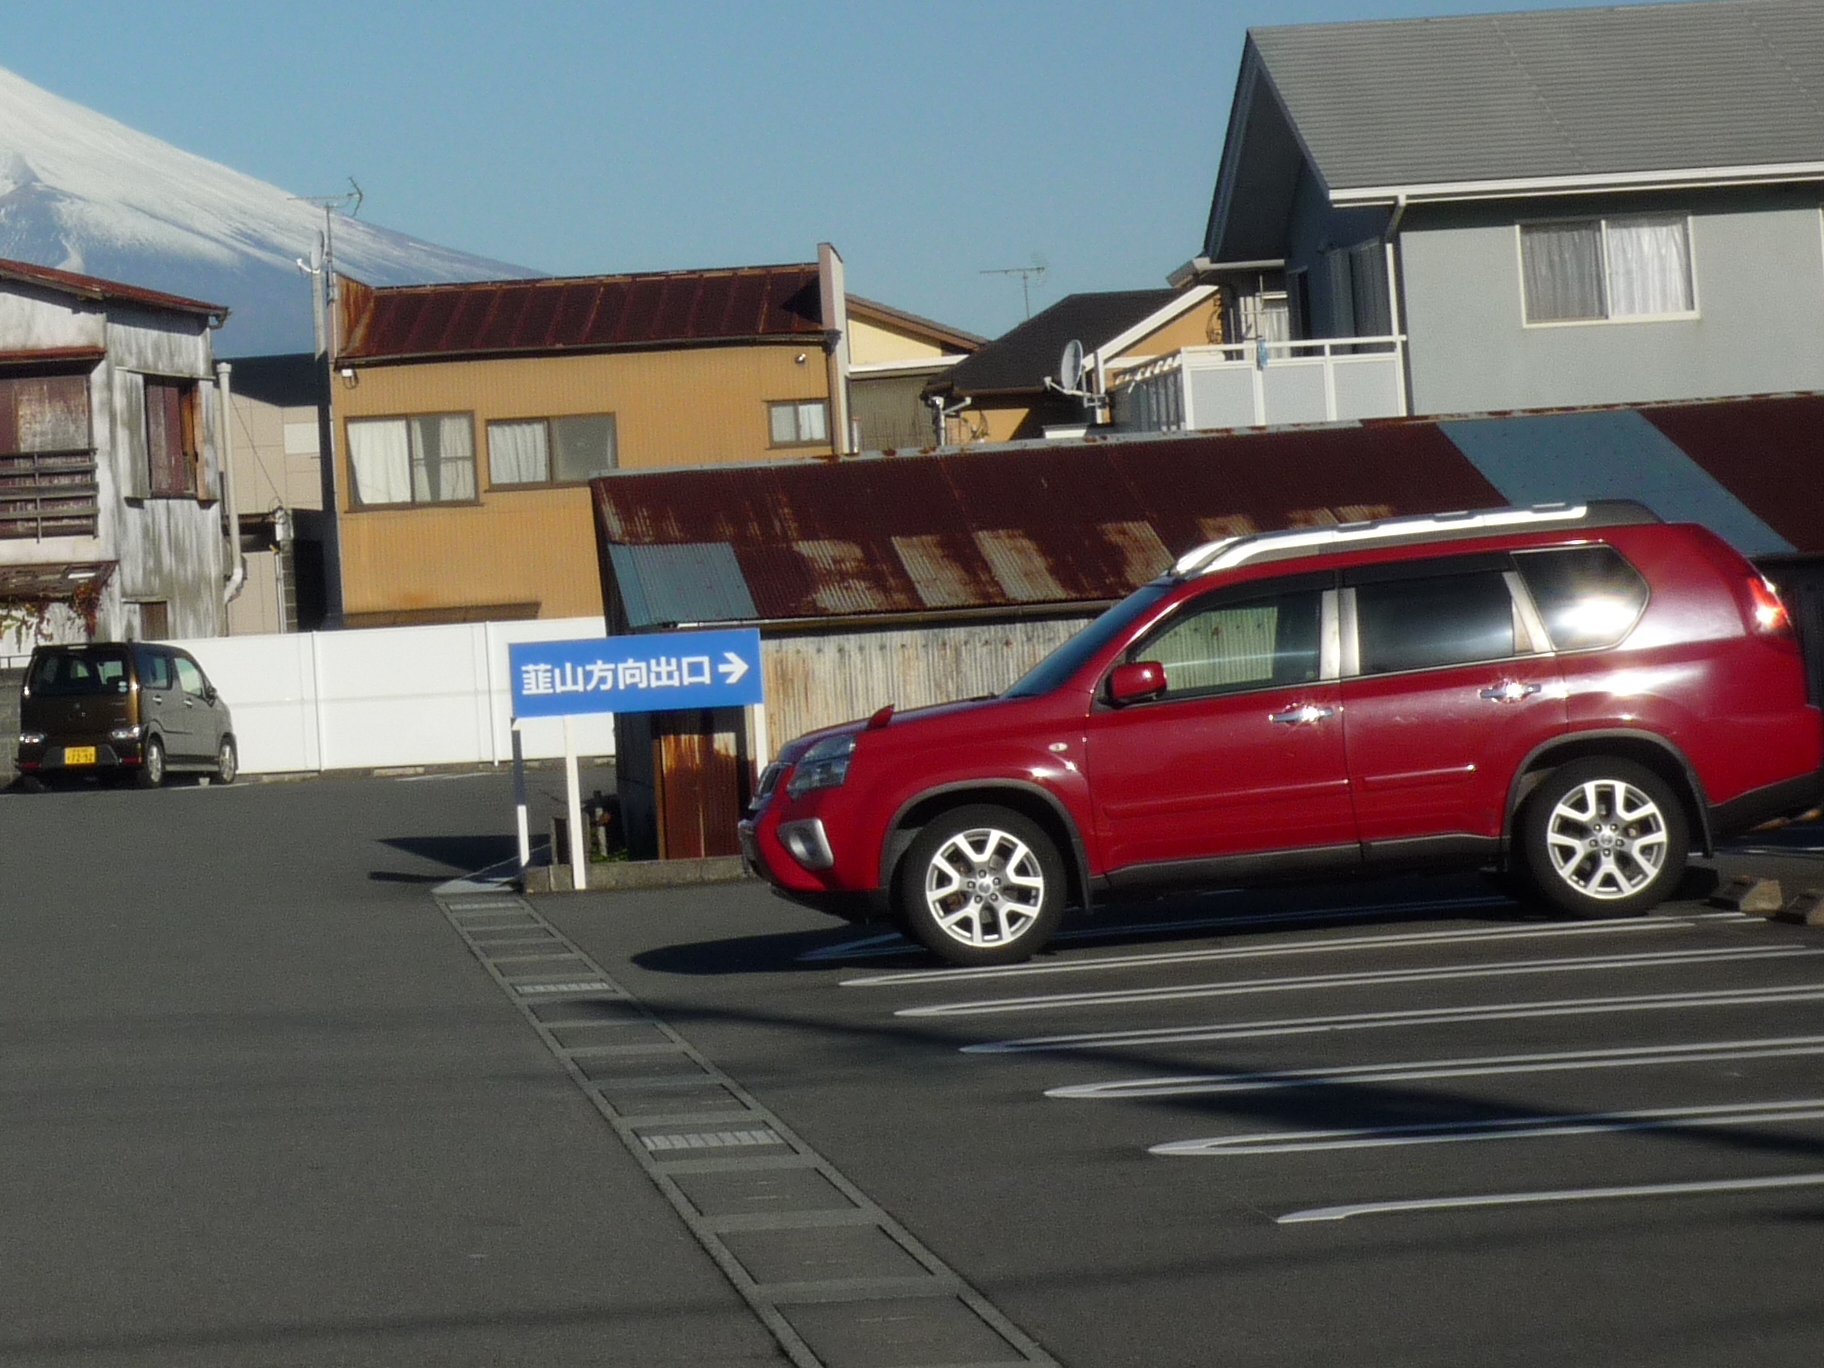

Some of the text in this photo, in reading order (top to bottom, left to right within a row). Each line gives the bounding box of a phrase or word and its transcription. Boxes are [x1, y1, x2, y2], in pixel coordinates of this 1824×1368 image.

[521, 656, 711, 696] 韮山方向出口
